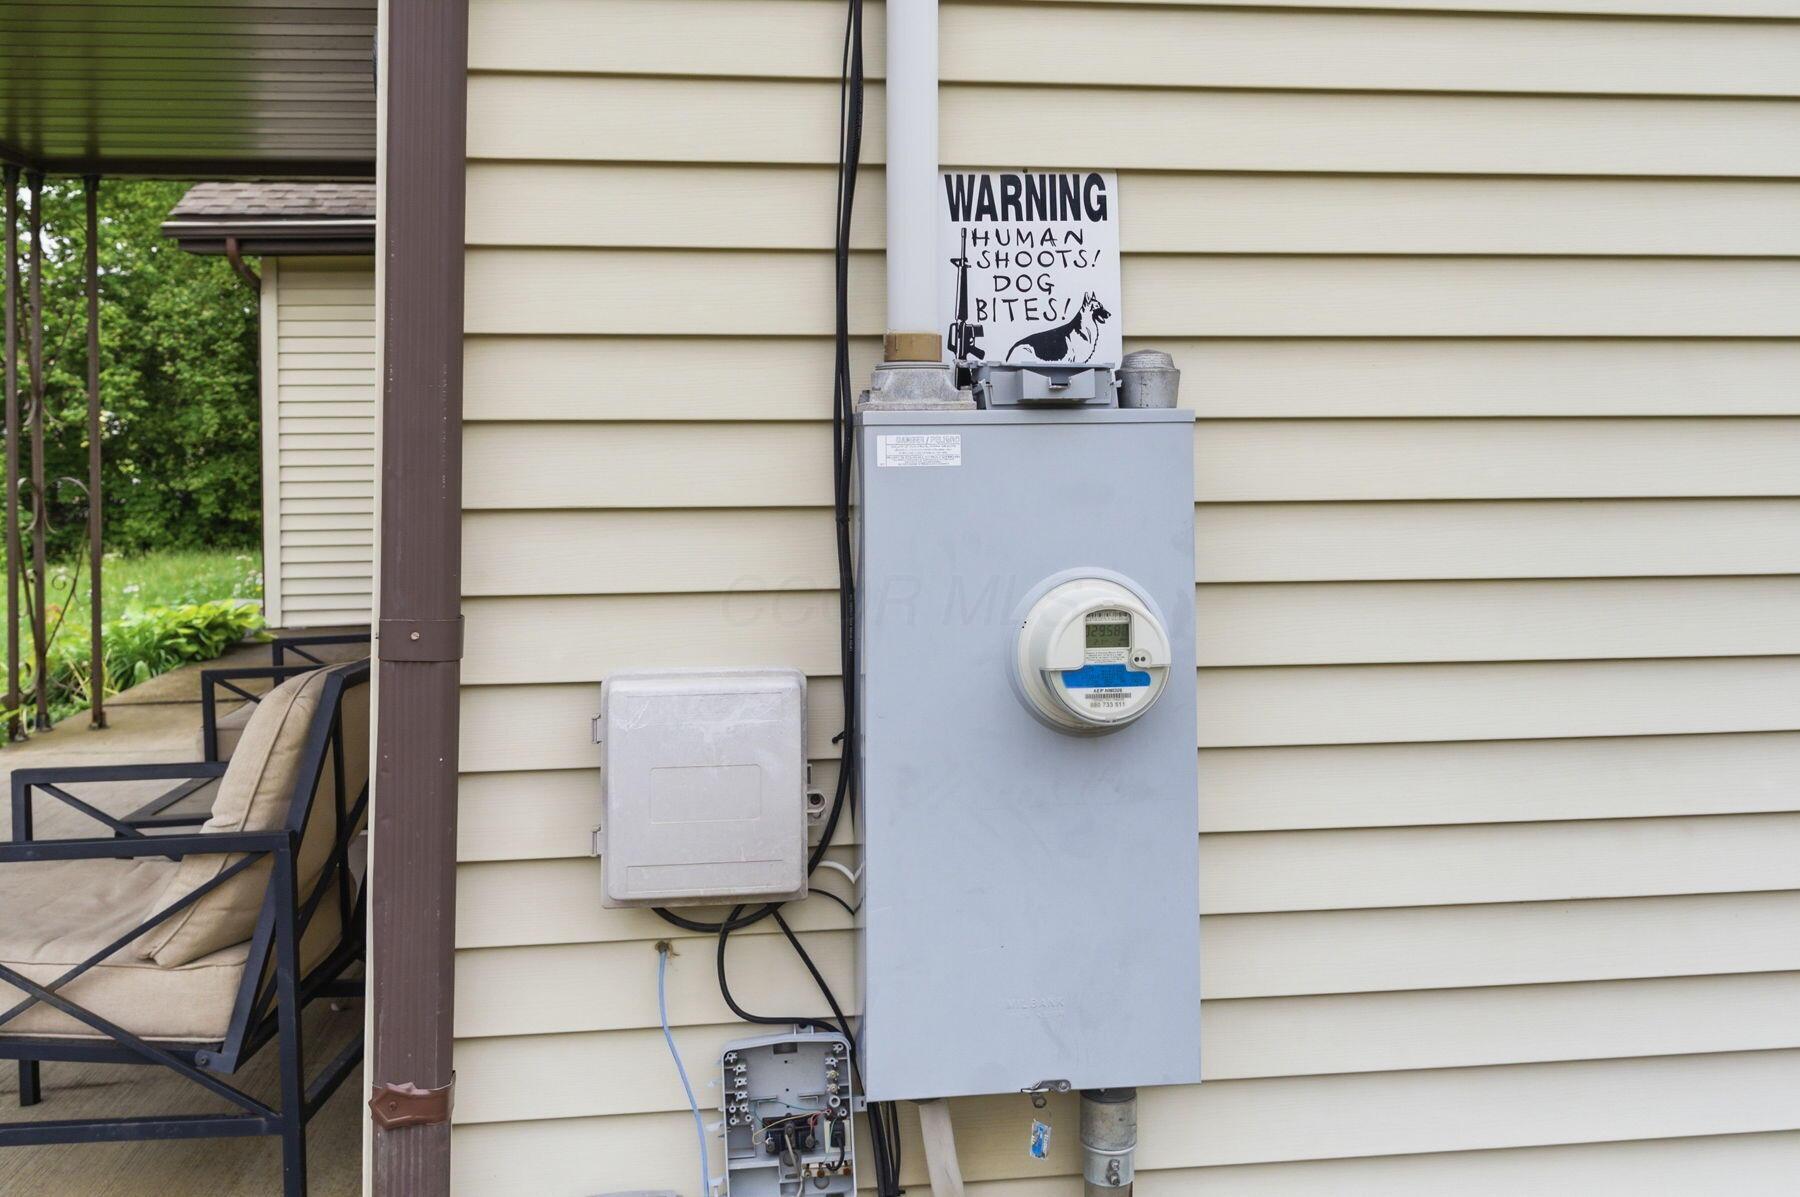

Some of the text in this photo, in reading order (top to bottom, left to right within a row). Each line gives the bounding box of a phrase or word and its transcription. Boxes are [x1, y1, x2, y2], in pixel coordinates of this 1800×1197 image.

[944, 173, 1107, 222] WARNING
[971, 227, 1083, 248] HUMAN
[976, 250, 1100, 269] SHOOTS!
[993, 273, 1055, 295] DOG
[976, 298, 1071, 322] BITES!
